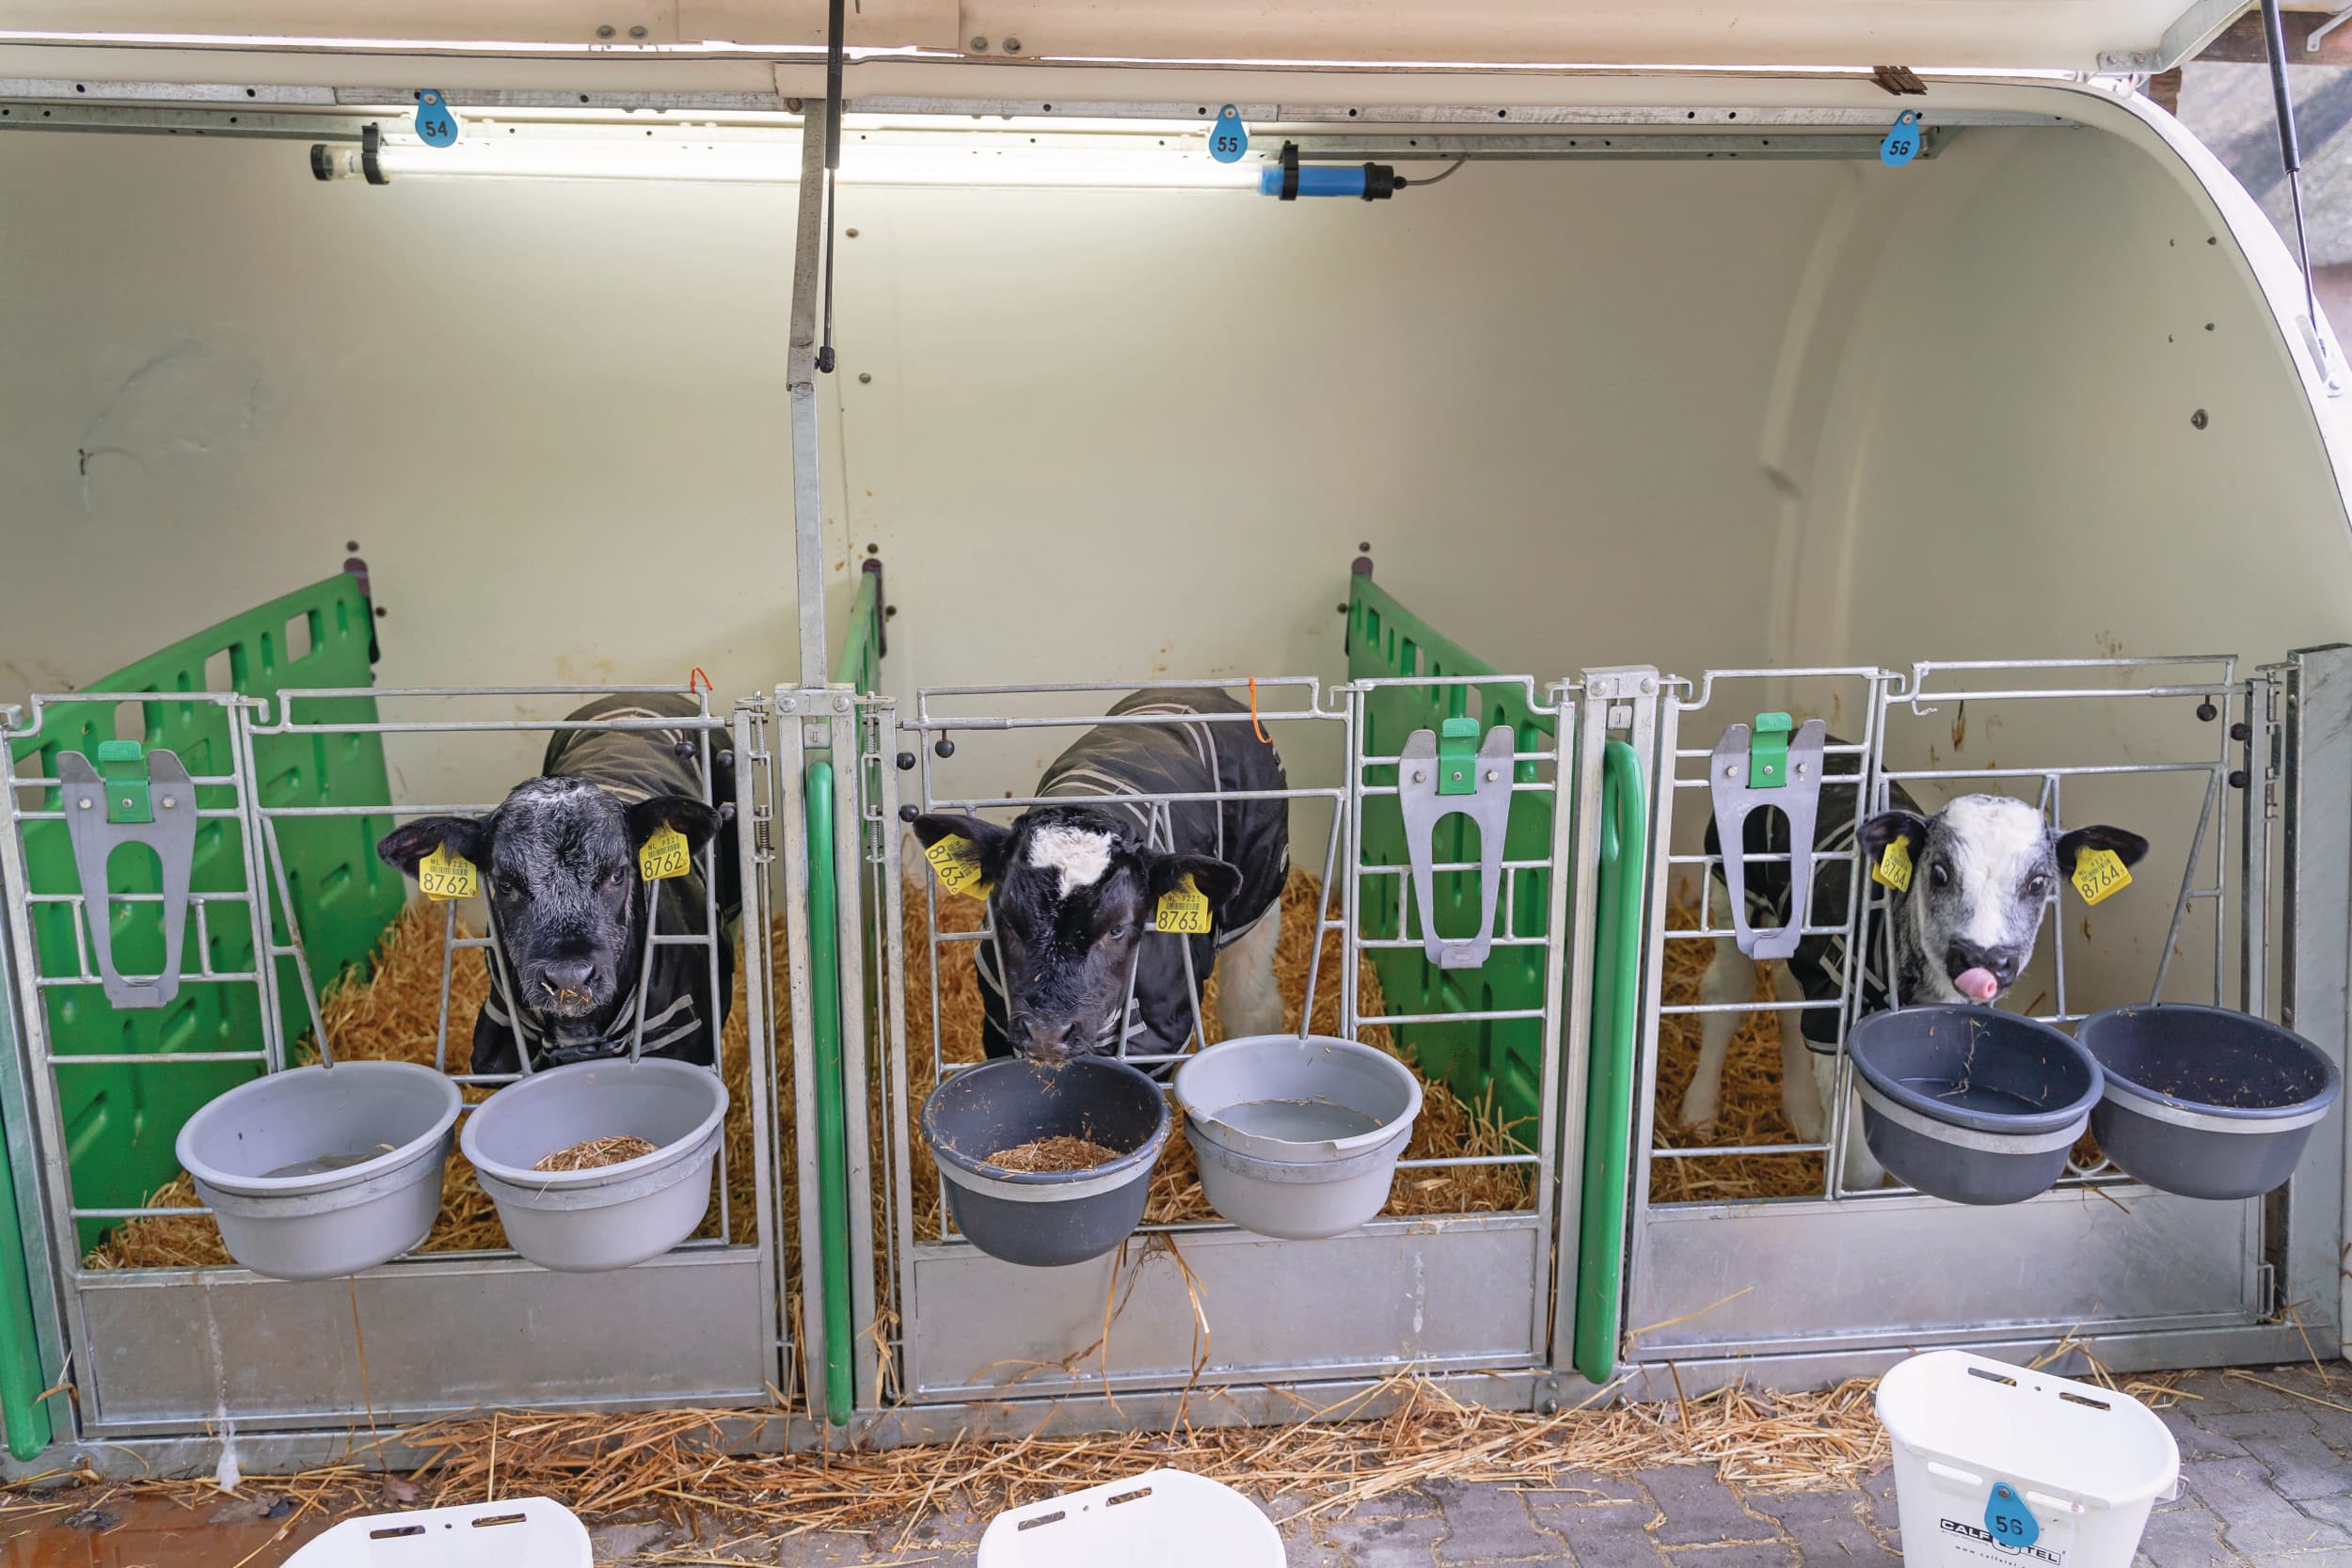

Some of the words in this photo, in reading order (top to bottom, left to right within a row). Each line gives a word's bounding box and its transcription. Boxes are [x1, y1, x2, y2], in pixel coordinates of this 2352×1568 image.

[424, 120, 448, 137] 54
[1217, 135, 1238, 153] 55
[1888, 140, 1911, 155] 56
[644, 850, 681, 879] 8762
[928, 845, 964, 886] 8763
[1883, 858, 1906, 888] 8764
[423, 873, 469, 895] 8762
[2081, 864, 2121, 898] 8764
[1158, 911, 1199, 930] 8763
[1995, 1515, 2024, 1536] 56
